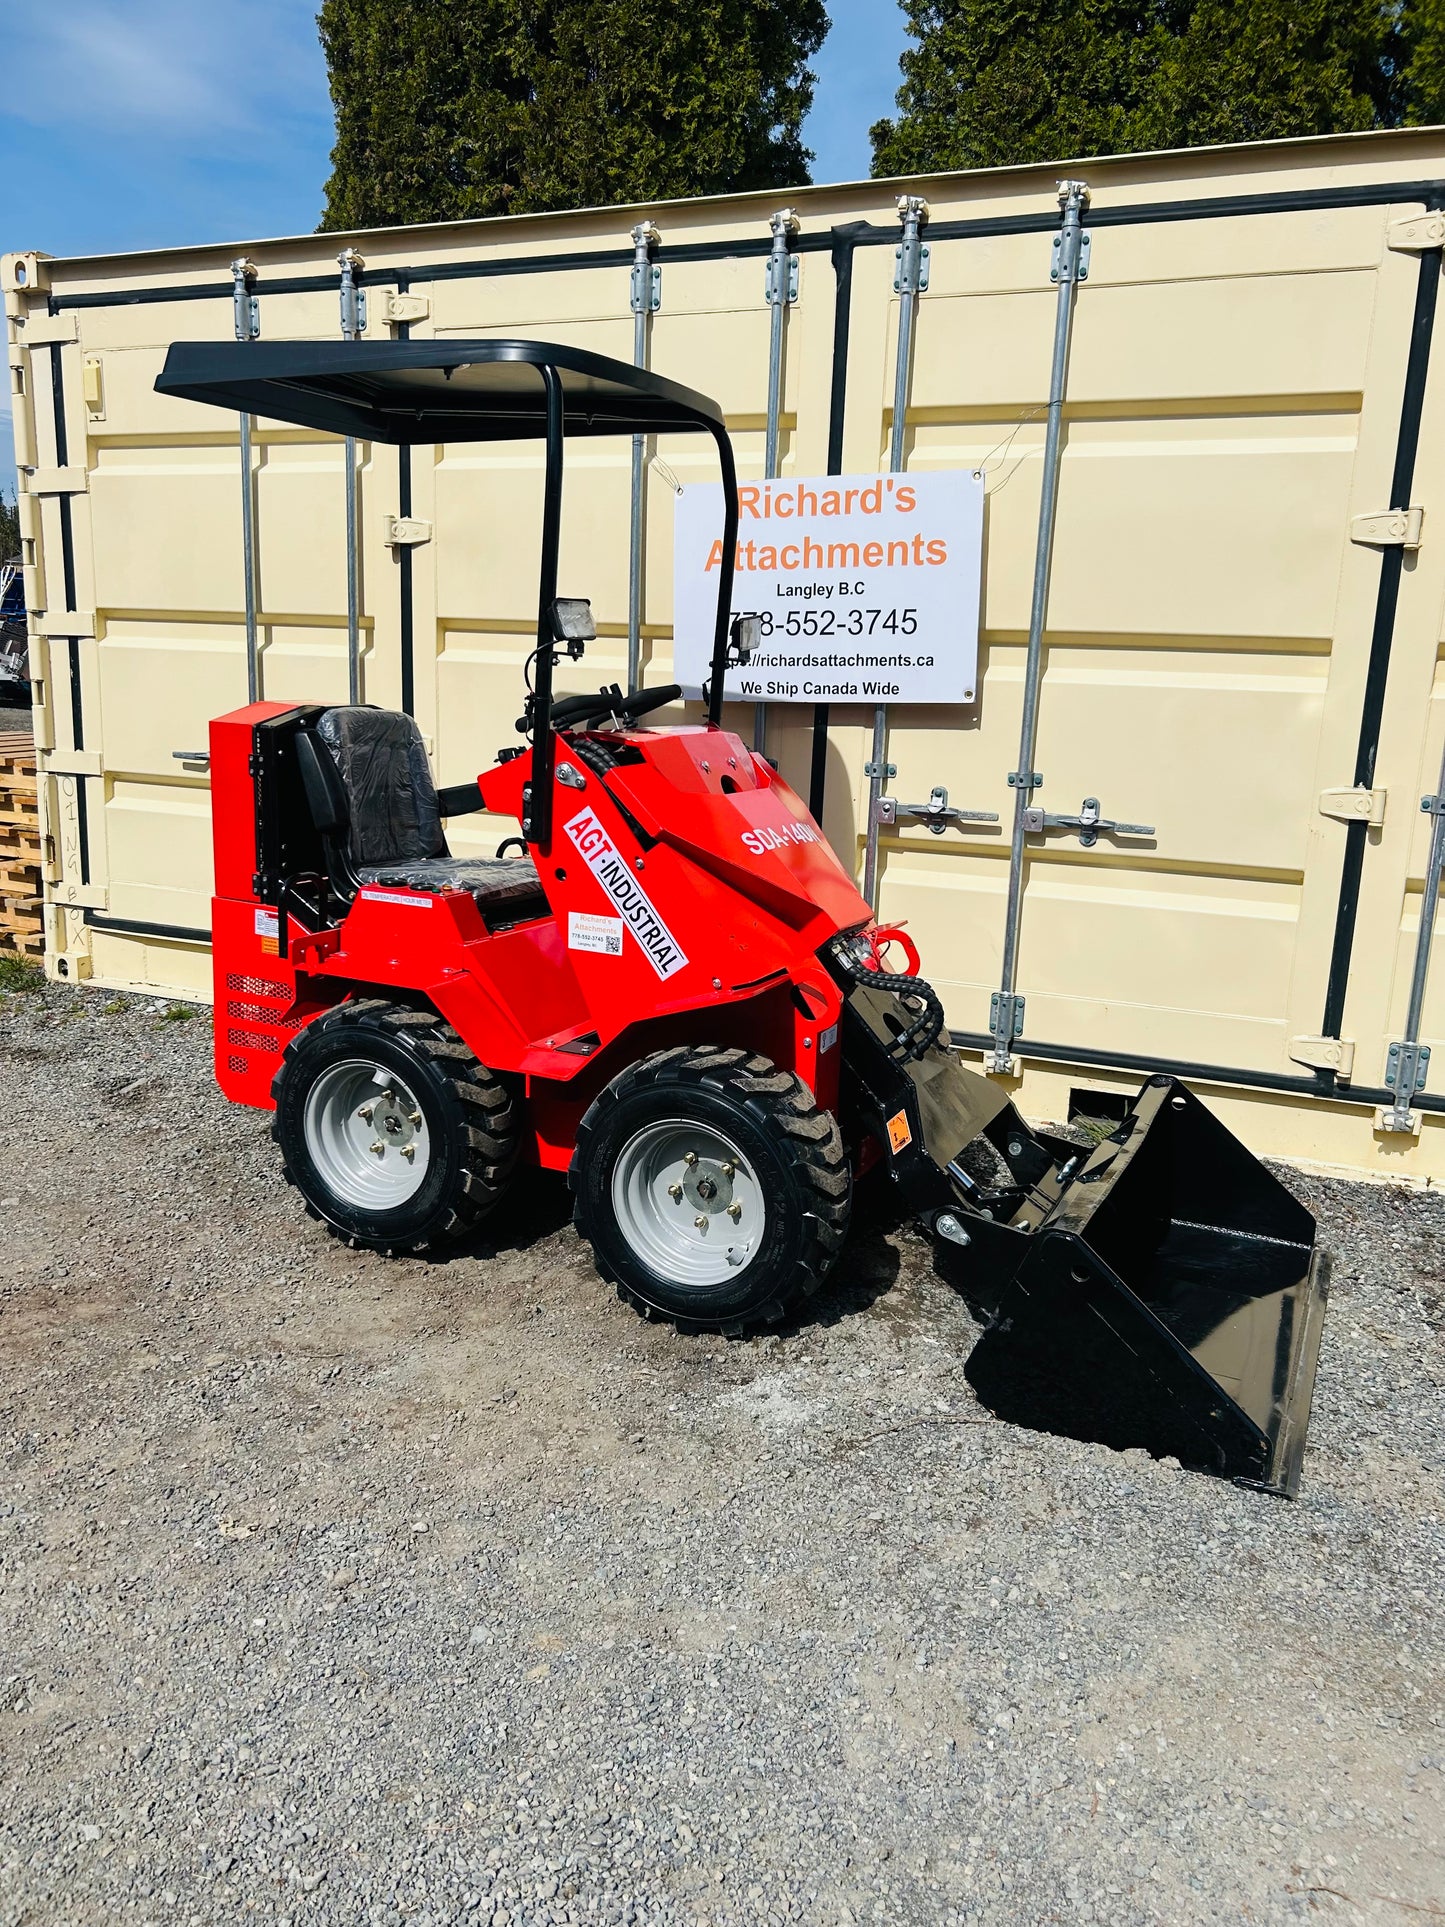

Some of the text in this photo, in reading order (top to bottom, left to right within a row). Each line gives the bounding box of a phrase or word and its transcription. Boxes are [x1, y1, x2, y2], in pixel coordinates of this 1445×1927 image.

[737, 479, 917, 519] Richard's
[704, 533, 948, 572] Attachments
[777, 581, 865, 599] Langley B.C
[740, 681, 900, 697] We Ship Canada Wide
[580, 915, 612, 924] Richard's
[574, 923, 617, 934] Attachments
